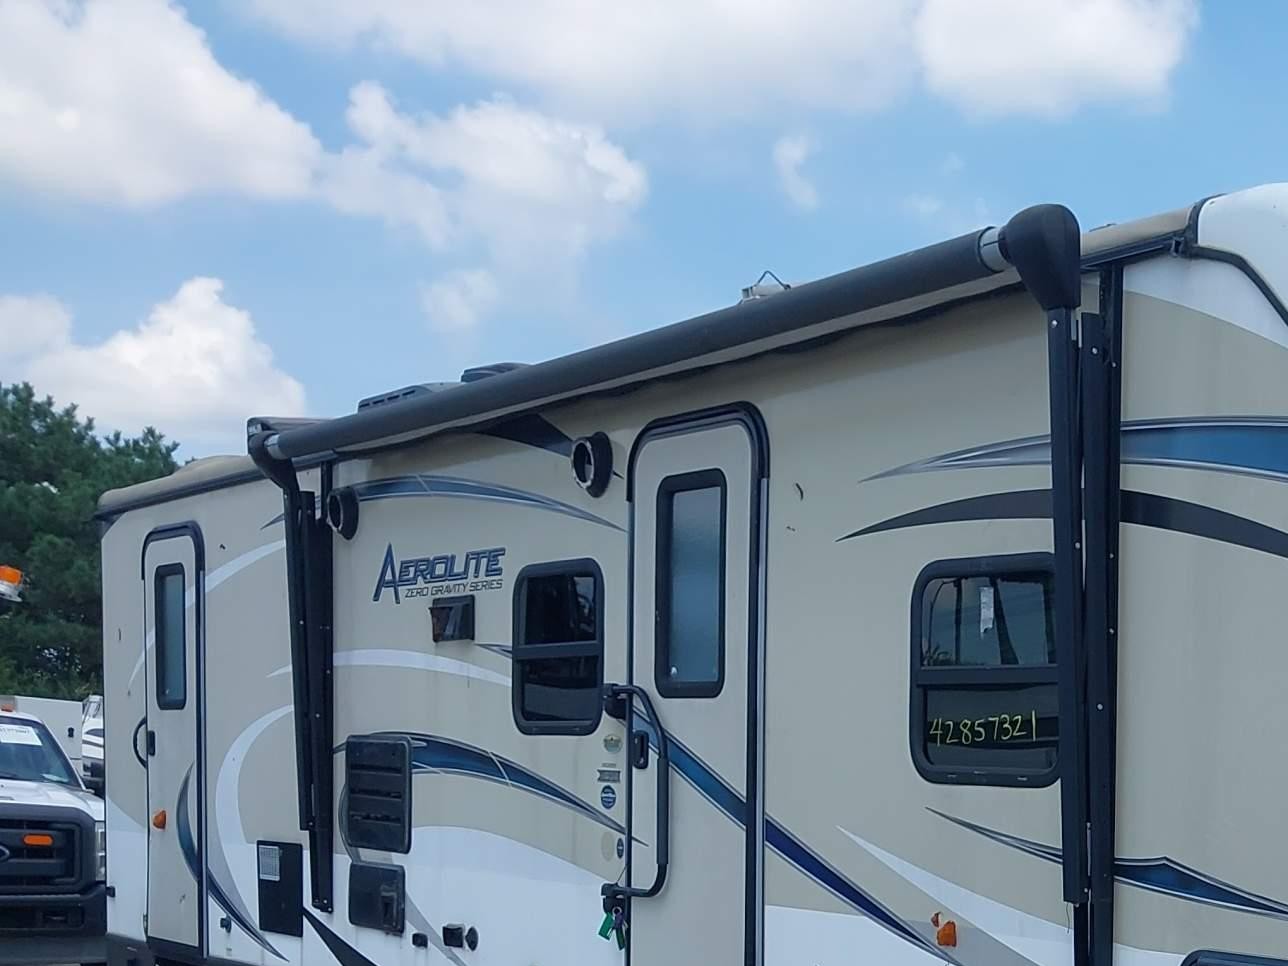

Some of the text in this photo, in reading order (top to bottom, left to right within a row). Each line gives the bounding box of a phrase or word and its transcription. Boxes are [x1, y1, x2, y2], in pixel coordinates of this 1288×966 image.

[373, 542, 506, 604] AEROLITE
[405, 579, 503, 599] ZERO GRAVITY SERIES
[929, 709, 1037, 747] 42857321
